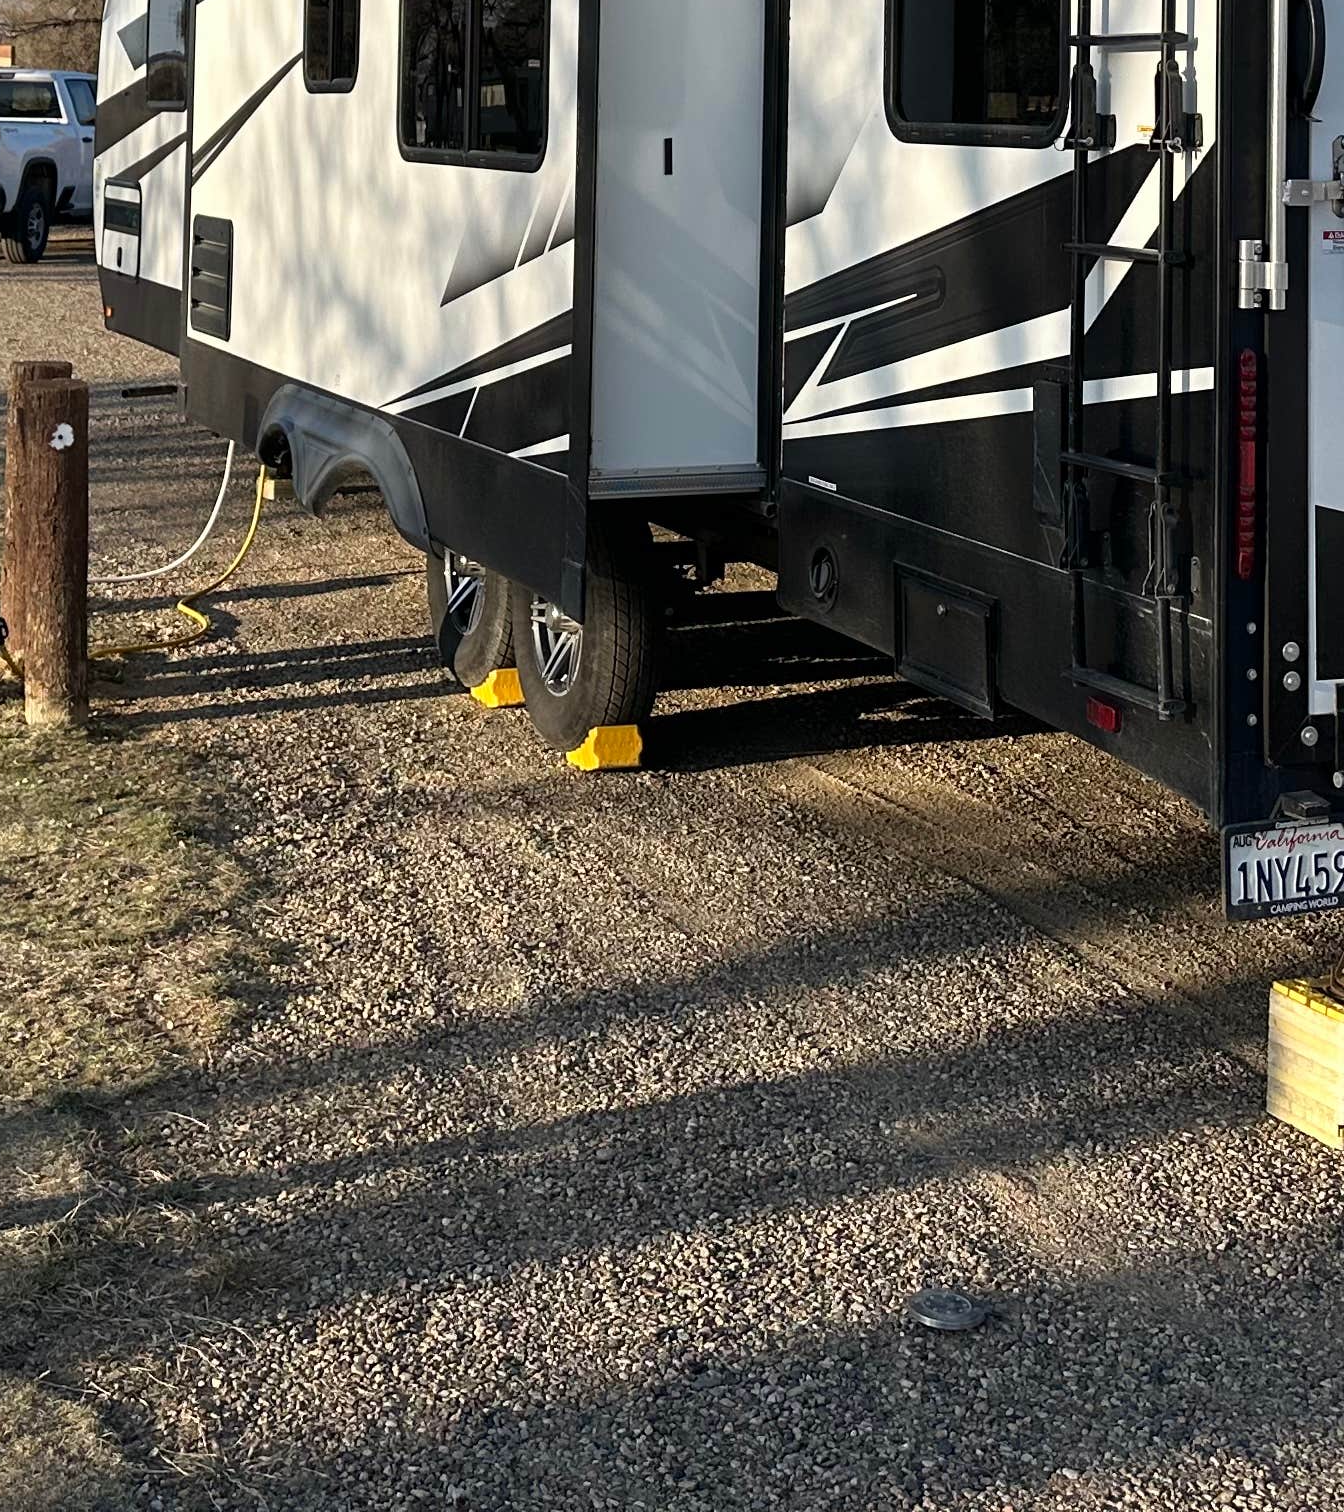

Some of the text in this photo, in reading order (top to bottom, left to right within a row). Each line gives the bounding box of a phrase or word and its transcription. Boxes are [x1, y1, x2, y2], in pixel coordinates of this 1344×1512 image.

[1232, 835, 1252, 848] AUG
[1270, 895, 1338, 915] CAMPING WORLD
